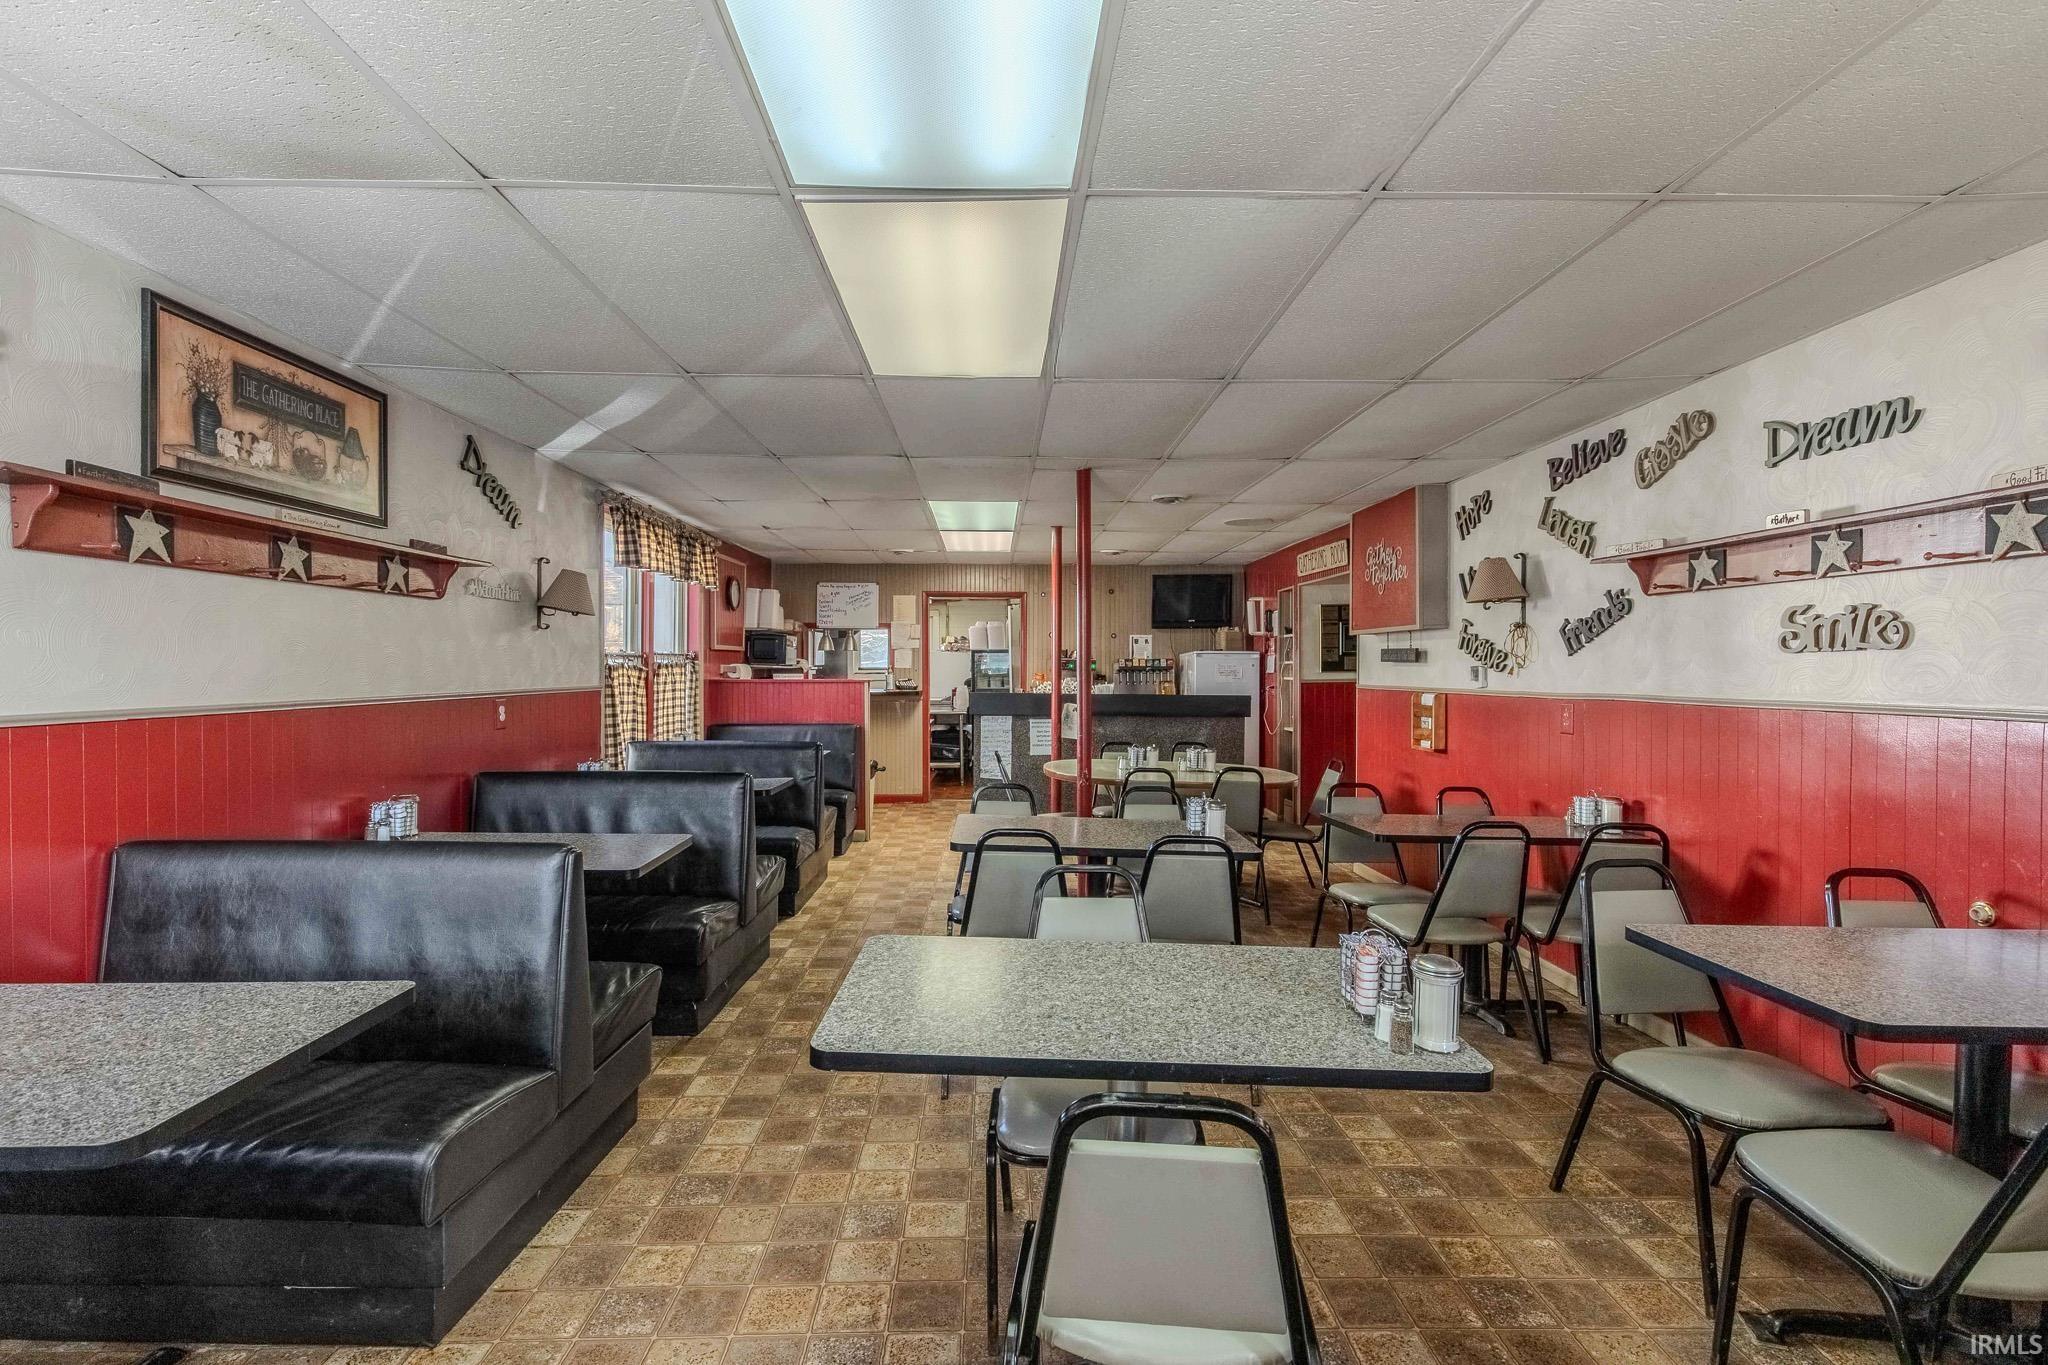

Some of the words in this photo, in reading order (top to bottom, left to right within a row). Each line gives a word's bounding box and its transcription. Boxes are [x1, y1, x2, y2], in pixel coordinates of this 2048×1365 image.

[241, 375, 259, 400] THE
[262, 384, 314, 420] GATHERING
[315, 404, 340, 428] PLACE
[1763, 396, 1926, 468] Dream
[460, 434, 523, 529] Dream
[1547, 429, 1626, 491] Believe
[1299, 548, 1327, 574] GATHERING
[1330, 542, 1347, 566] ROOM
[1538, 497, 1597, 558] Laugh
[1458, 618, 1508, 672] Forgive
